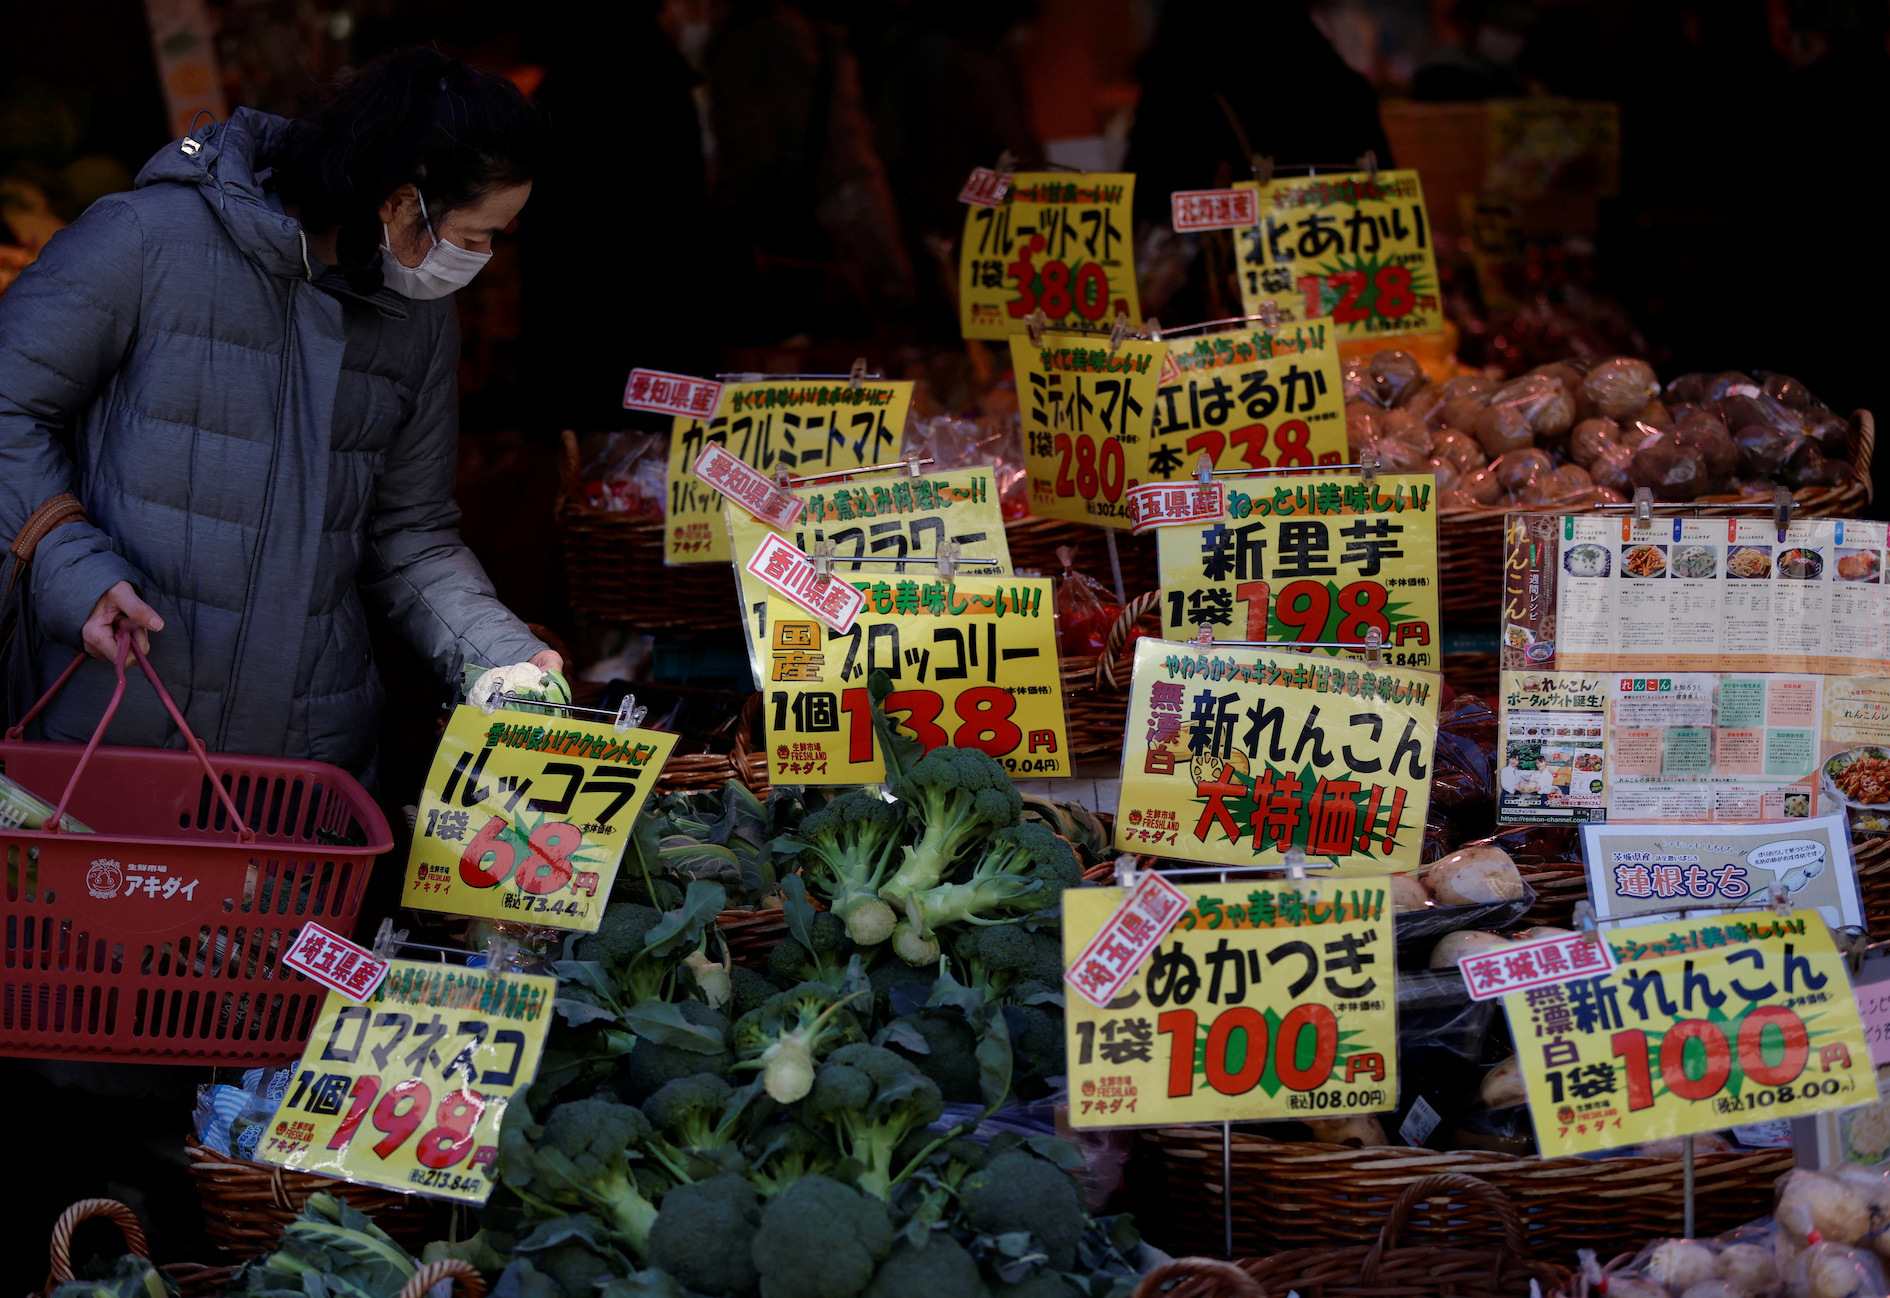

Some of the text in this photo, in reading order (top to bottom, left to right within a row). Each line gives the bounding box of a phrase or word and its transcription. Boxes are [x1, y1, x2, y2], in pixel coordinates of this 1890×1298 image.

[977, 206, 1122, 259] フルーツトマト
[1242, 205, 1426, 266] 北あかり
[630, 376, 715, 413] 愛知県産
[682, 410, 894, 474] カラフルミニトマト
[706, 454, 790, 520] 愛知県産
[1130, 484, 1219, 525] 埼玉県産
[1201, 519, 1404, 582] 新里芋
[1504, 521, 1530, 620] れんこん
[768, 547, 852, 621] 香川県産
[1529, 568, 1540, 621] 一週間レシピ
[771, 620, 825, 682] 国産
[828, 622, 1040, 684] ブロッコリー
[1507, 691, 1605, 708] ポータルサイト誕生!
[1541, 678, 1593, 694] れんこん
[772, 691, 840, 733] 1個
[1144, 680, 1185, 776] 無漂白
[792, 743, 821, 751] 生鮮市場
[1189, 689, 1427, 780] 新れんこん
[776, 762, 828, 775] アキダイ
[791, 751, 827, 761] FRESHLAND
[440, 747, 643, 824] ルッコラ
[1142, 817, 1180, 831] FRESHLAND
[1146, 809, 1176, 822] 生鮮市場
[1193, 763, 1408, 858] 大特価!!
[1500, 815, 1589, 823] https://renkon-channel.com/
[1125, 828, 1179, 846] アキダイ
[1612, 851, 1652, 863] 茨城県産
[124, 876, 200, 901] アキダイ
[127, 864, 168, 873] 生鮮市場
[413, 880, 451, 895] アキダイ
[428, 873, 451, 883] FRESHLAND
[1613, 863, 1751, 899] 蓮根もち
[1078, 881, 1177, 994] 埼玉県産
[298, 933, 379, 992] 埼玉県産
[1471, 940, 1602, 990] 茨城県産
[1566, 944, 1828, 1035] 新れんこん
[320, 1006, 526, 1088] ロマネスコ
[1081, 1098, 1138, 1115] アキダイ
[267, 1137, 310, 1154] アキダイ
[1557, 1117, 1624, 1139] アキダイ
